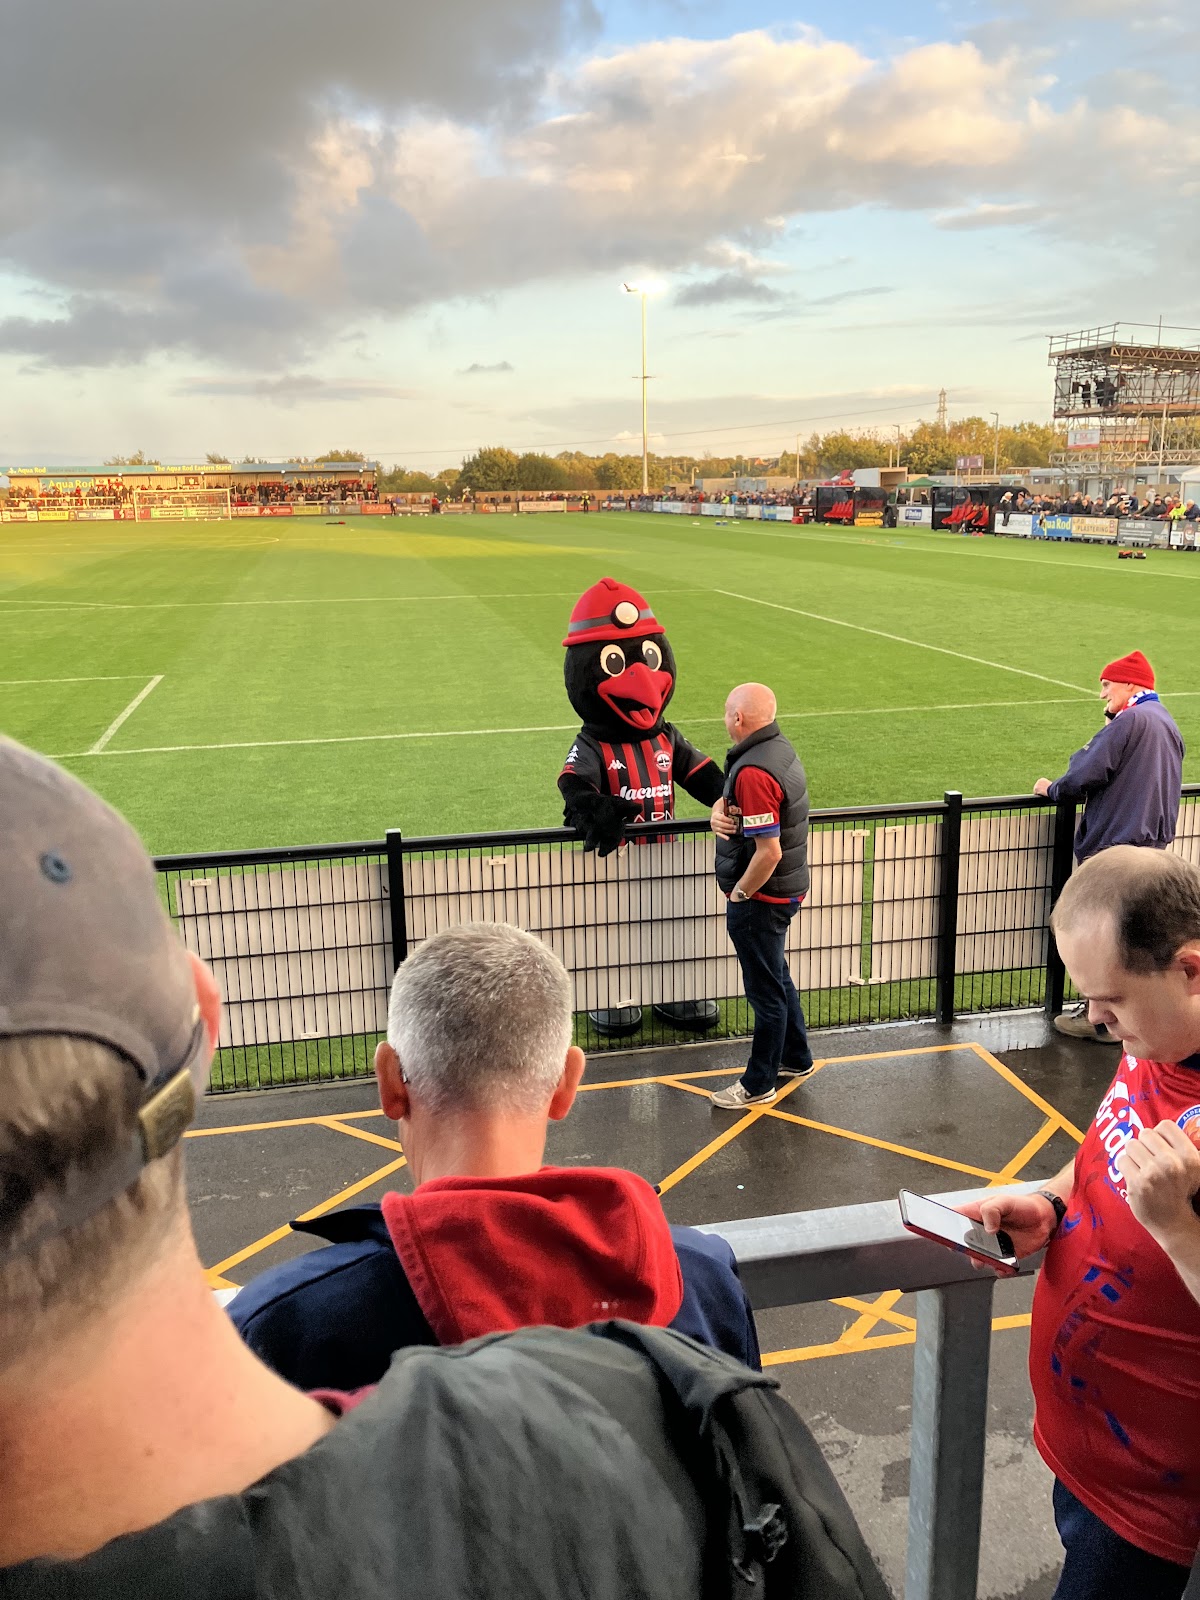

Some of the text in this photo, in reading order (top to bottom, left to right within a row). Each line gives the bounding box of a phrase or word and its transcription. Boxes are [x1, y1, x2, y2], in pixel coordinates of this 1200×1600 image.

[17, 467, 34, 475] Aqua
[34, 466, 47, 474] Rod
[167, 465, 181, 473] Aqua
[48, 478, 95, 493] Aqua Rod
[1056, 518, 1071, 530] Rod
